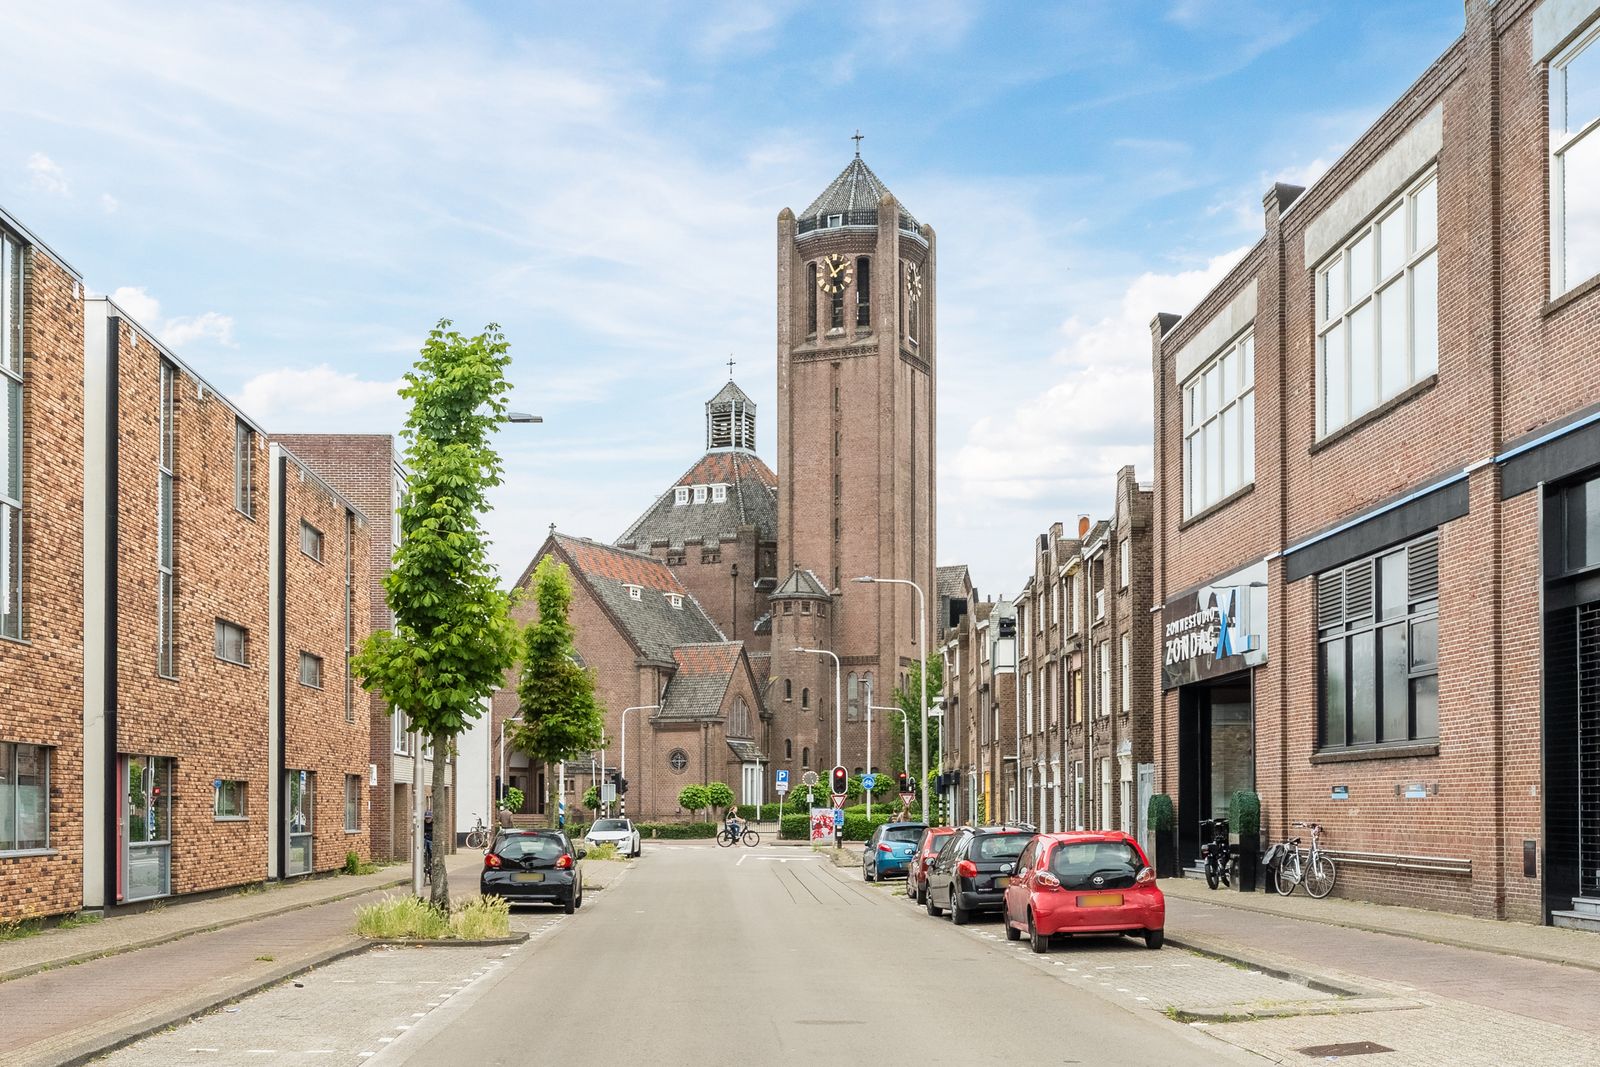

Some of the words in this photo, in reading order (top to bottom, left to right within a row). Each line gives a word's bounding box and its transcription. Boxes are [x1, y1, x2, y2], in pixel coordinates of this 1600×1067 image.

[1166, 606, 1215, 637] ZONNESTUDIO
[1166, 625, 1215, 666] ZONDAG
[1215, 586, 1260, 660] XL
[778, 772, 786, 780] P
